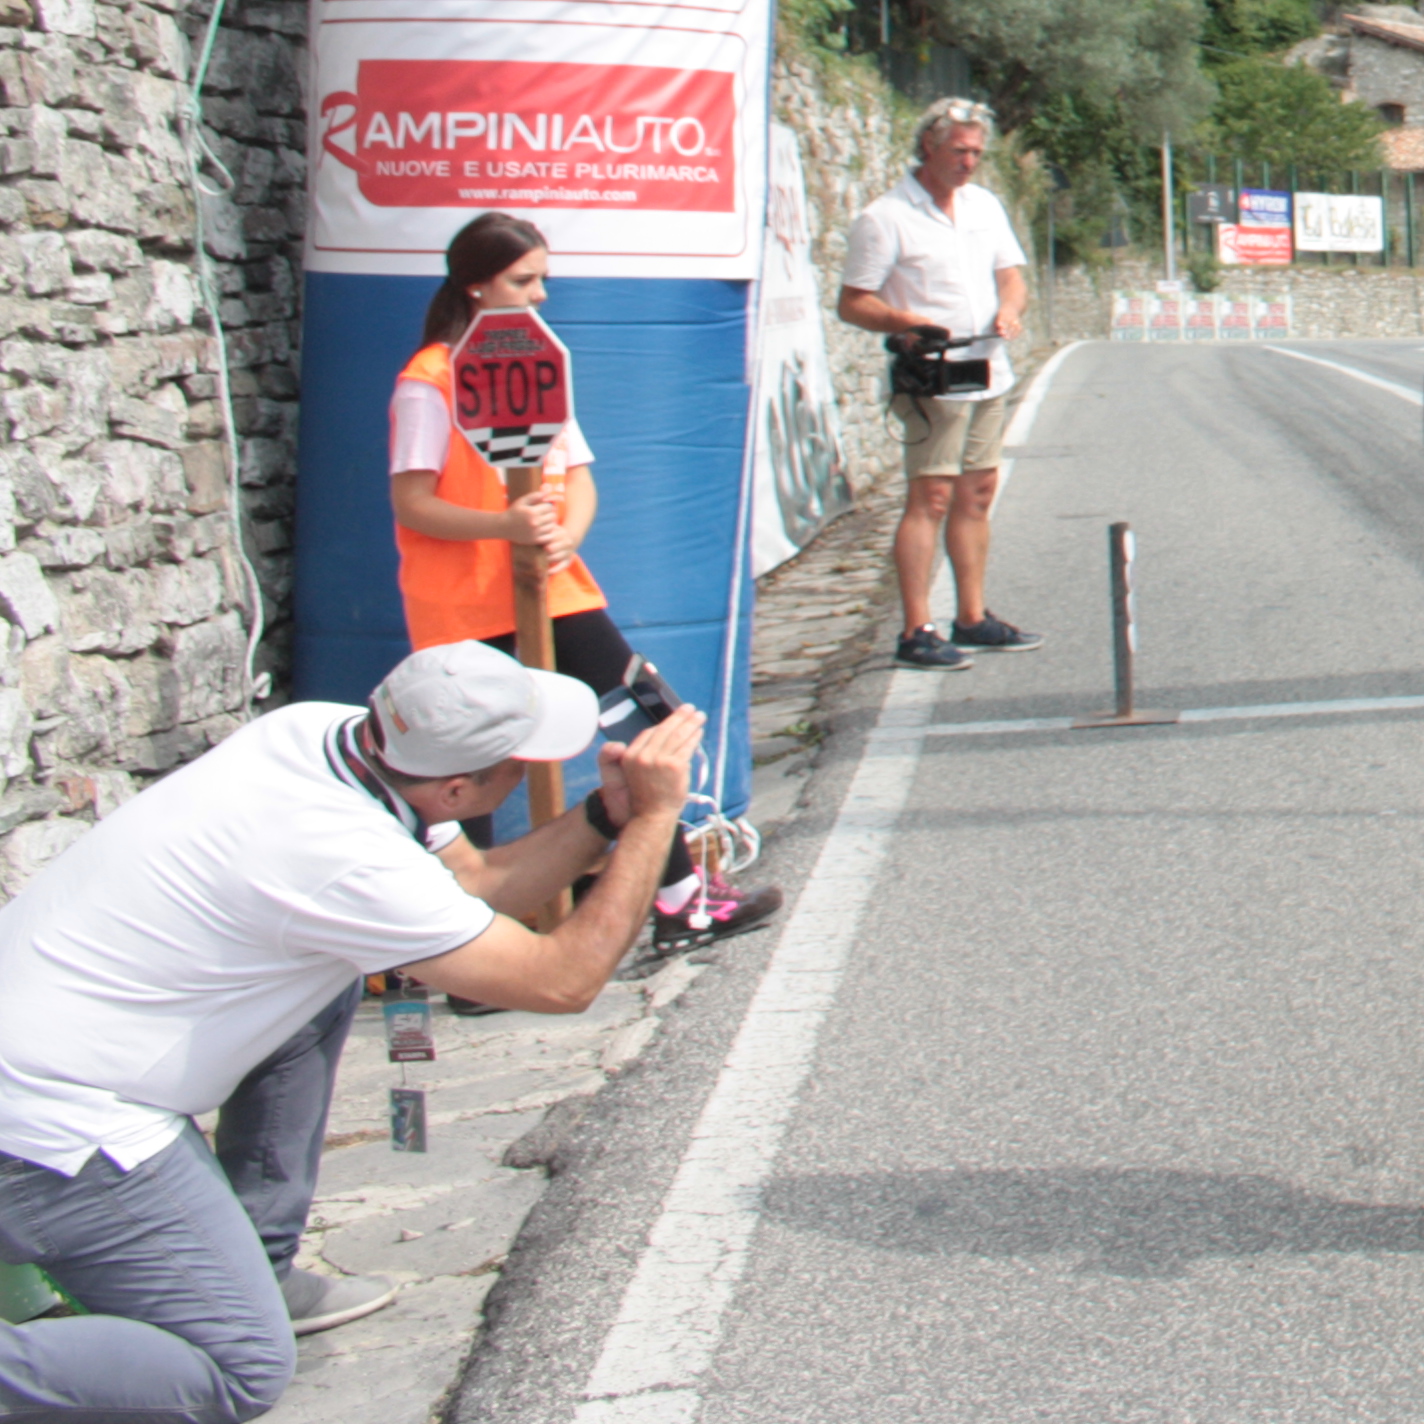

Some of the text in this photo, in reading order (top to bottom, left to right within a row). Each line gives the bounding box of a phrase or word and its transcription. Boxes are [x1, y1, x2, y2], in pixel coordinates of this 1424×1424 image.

[376, 160, 719, 183] NUOVE E USATE PLURIMARCA
[458, 187, 637, 203] www.rampiniauto.com
[459, 360, 558, 418] STOP
